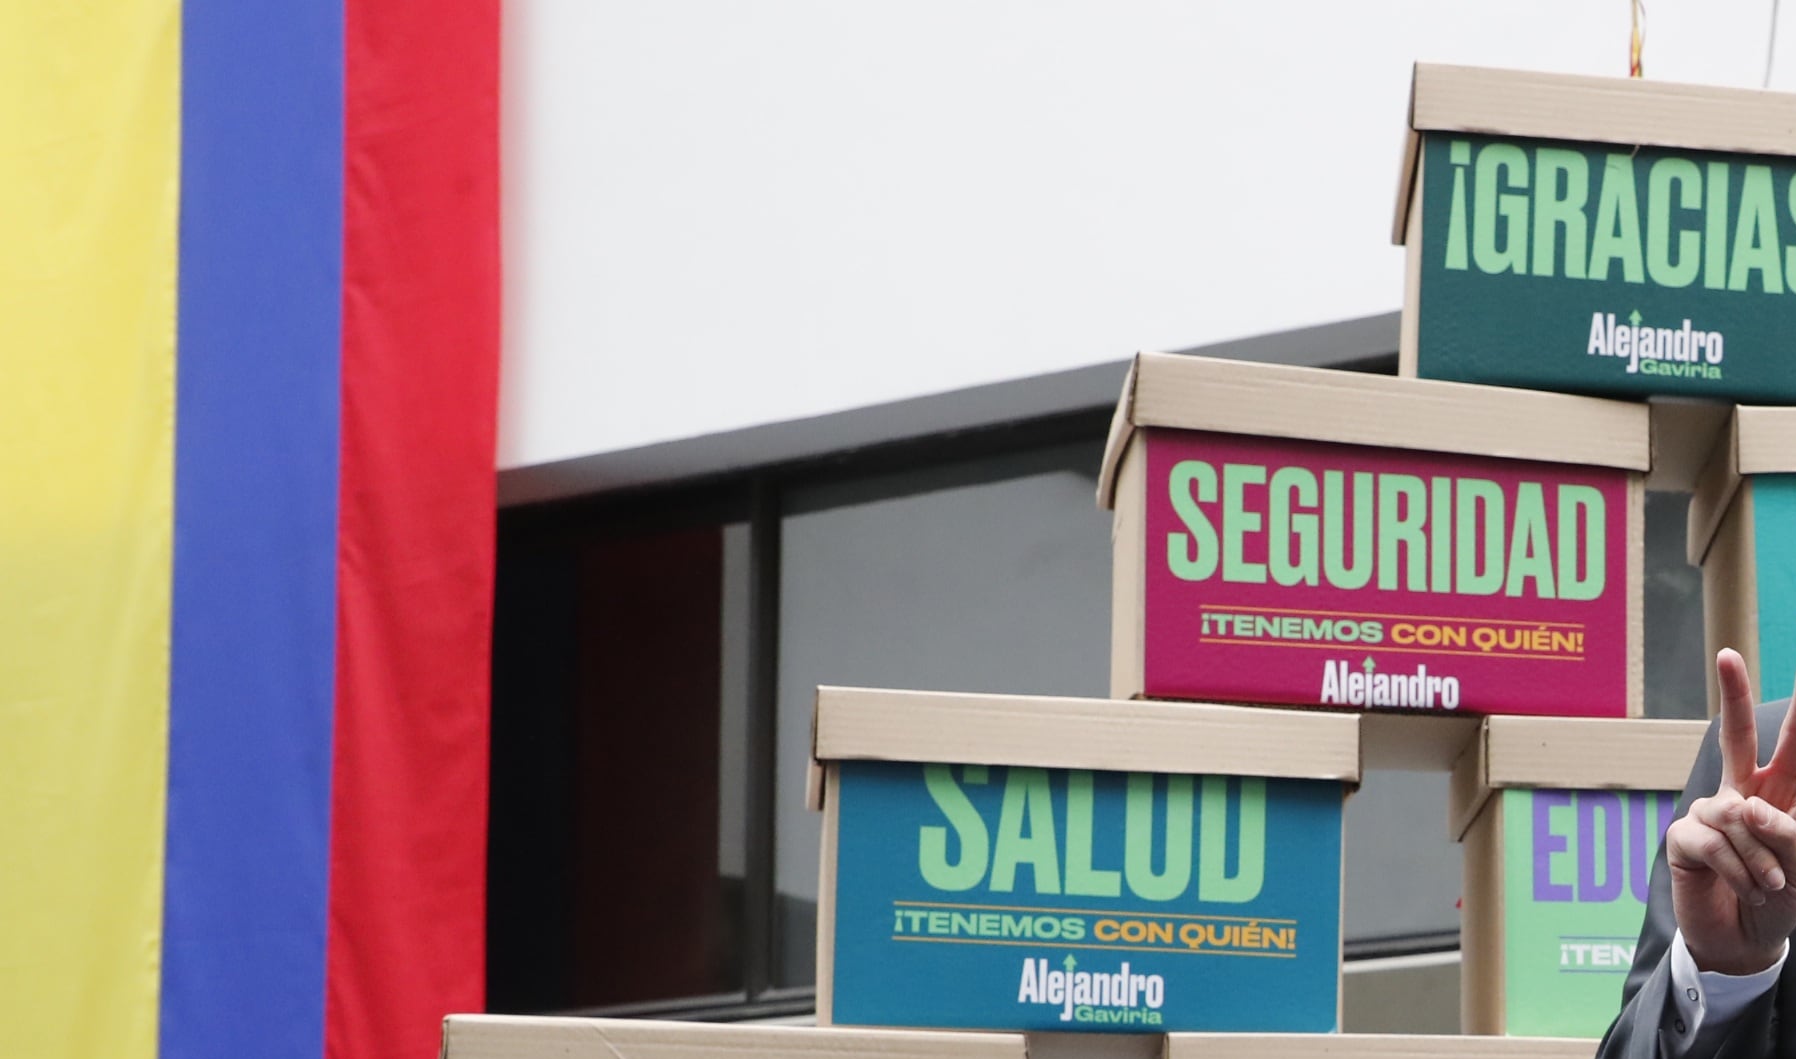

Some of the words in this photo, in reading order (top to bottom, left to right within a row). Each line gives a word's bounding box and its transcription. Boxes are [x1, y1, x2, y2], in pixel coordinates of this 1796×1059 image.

[1588, 313, 1723, 373] Alejandro
[1640, 359, 1722, 380] Gaviria
[1168, 460, 1606, 601] SEGURIDAD
[1201, 612, 1383, 643] ¡TENEMOS
[1391, 623, 1467, 648] CON
[1473, 625, 1584, 653] QUIÉN!
[919, 765, 1267, 903] SALUD
[895, 909, 1085, 938] ¡TENEMOS
[1094, 920, 1174, 945] CON
[1179, 922, 1296, 950] QUIÉN!
[1018, 957, 1164, 1022] Alejandro
[1075, 1006, 1162, 1025] Gaviria
